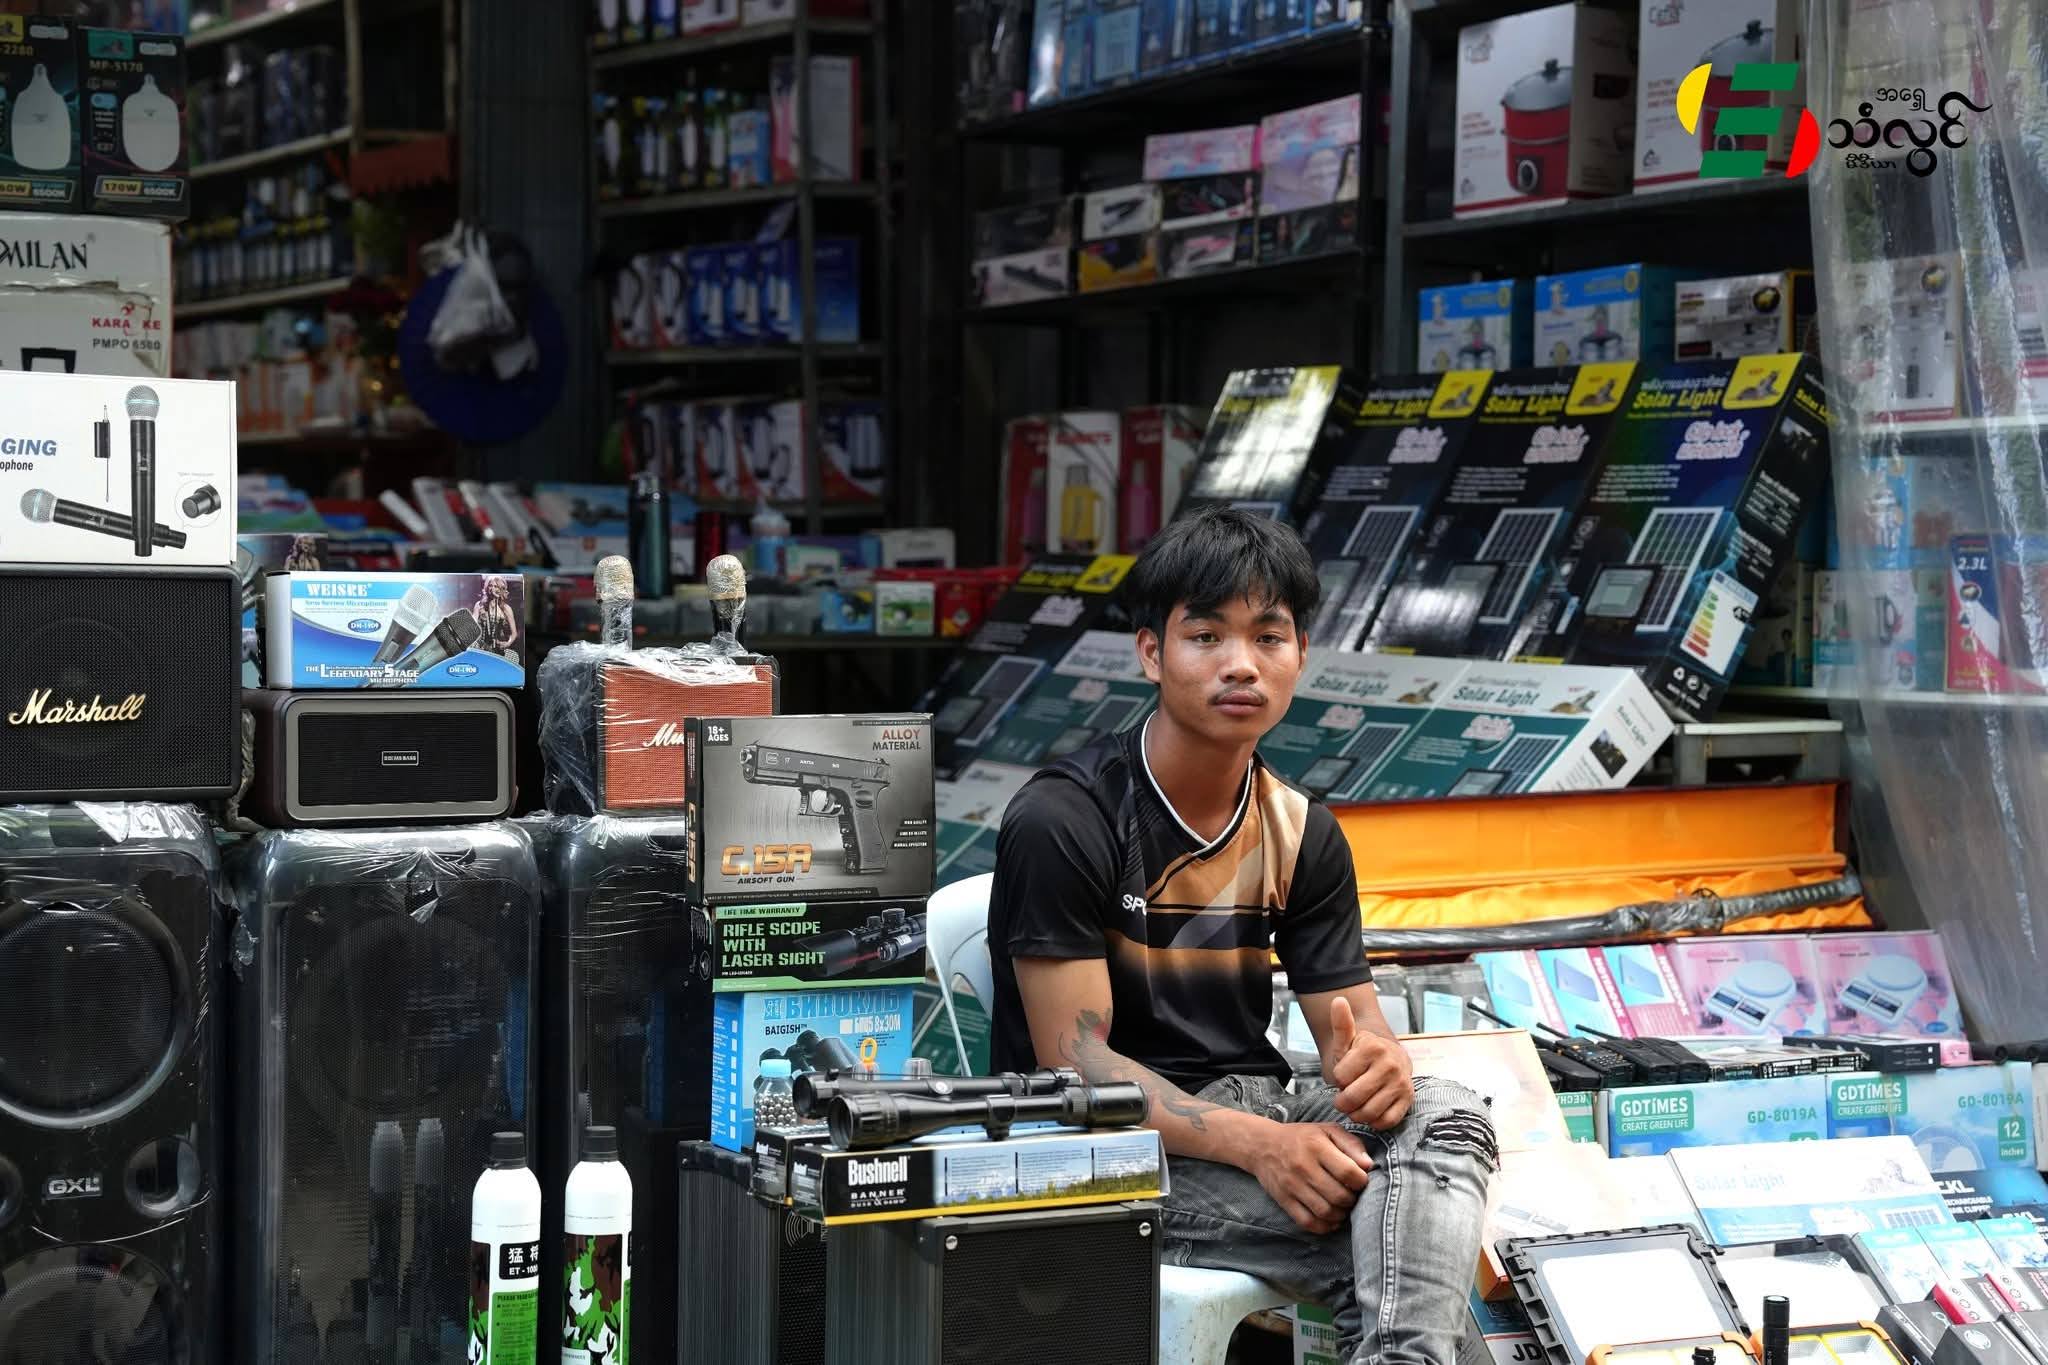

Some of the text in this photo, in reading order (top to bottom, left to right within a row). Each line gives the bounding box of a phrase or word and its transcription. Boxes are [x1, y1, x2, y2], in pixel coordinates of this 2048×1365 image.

[93, 338, 129, 350] PMPO
[0, 438, 57, 457] GING
[320, 663, 384, 678] LEGENDARY
[384, 663, 420, 678] STAGE
[1452, 685, 1541, 708] Solar Light
[8, 688, 147, 725] Marshall
[707, 725, 725, 735] 18+
[882, 729, 921, 741] ALLOY
[707, 733, 729, 742] AGES
[872, 741, 921, 751] MATERIAL
[720, 842, 814, 876] C.15A
[737, 875, 795, 885] AIRSOFT GUN
[758, 906, 801, 915] WARRANTY
[723, 921, 821, 937] RIFLE SCOPE
[723, 938, 766, 952] WITH
[722, 951, 826, 968] LASER SIGHT
[765, 1024, 801, 1036] BAIGISH
[1747, 1105, 1818, 1124] GD-8019A
[1621, 1118, 1689, 1132] CREATE GREEN LIFE
[2003, 1121, 2021, 1138] 12
[848, 1155, 908, 1187] Bushnell
[851, 1188, 904, 1200] BANNER
